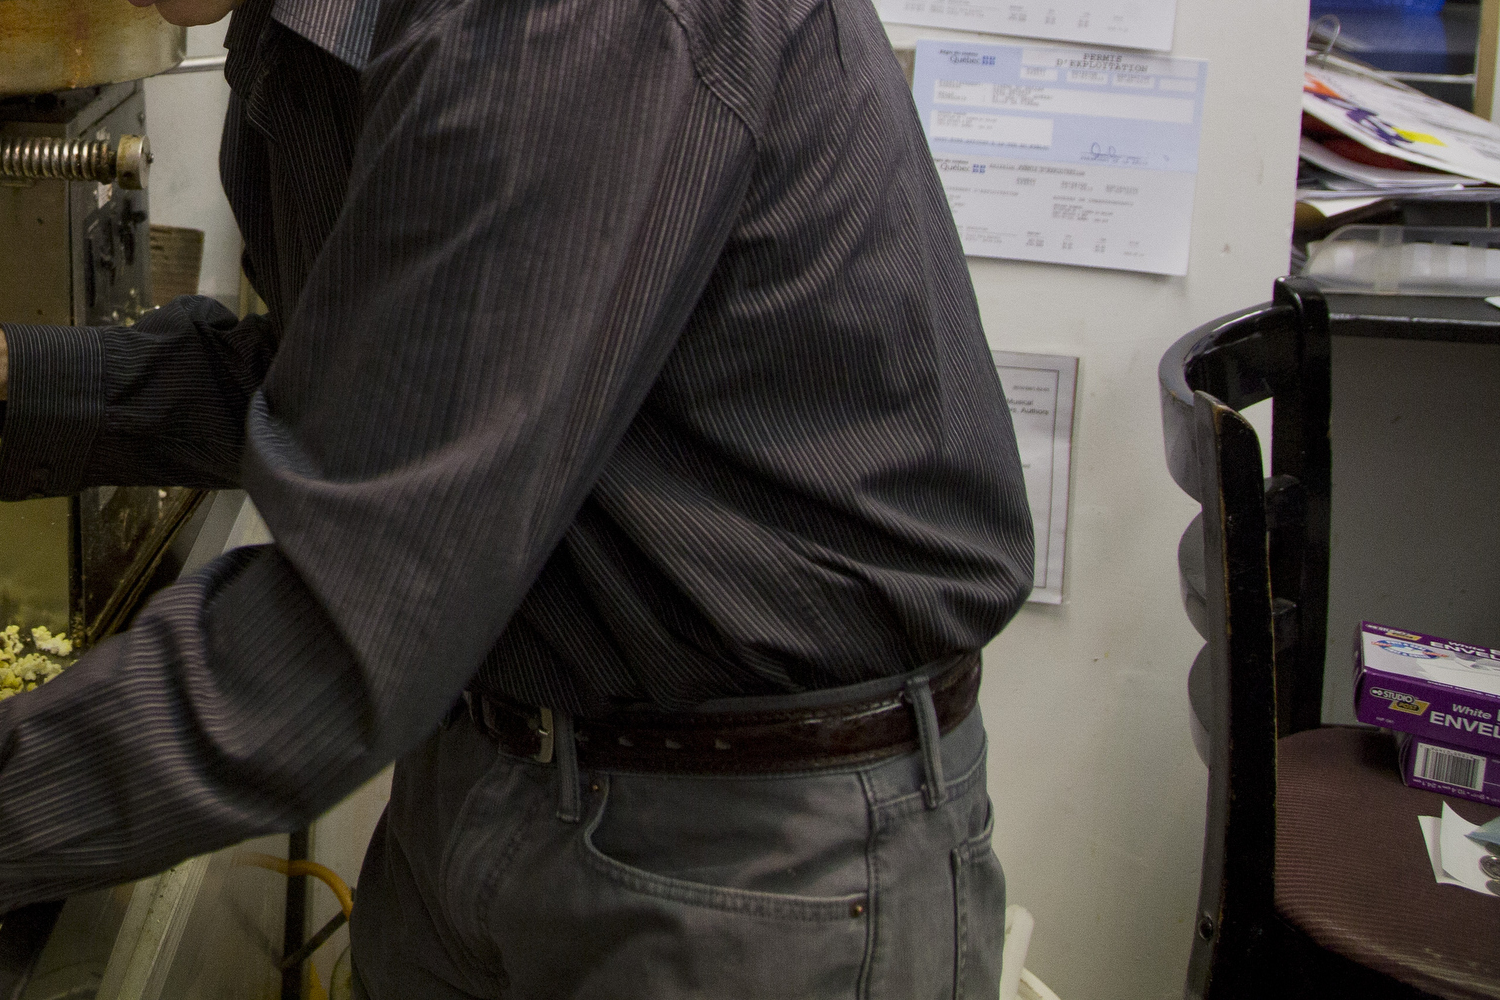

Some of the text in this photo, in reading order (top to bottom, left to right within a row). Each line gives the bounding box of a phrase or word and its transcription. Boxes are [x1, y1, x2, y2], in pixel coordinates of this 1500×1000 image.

[1083, 52, 1123, 63] PERMIS
[1056, 58, 1149, 73] D'EXPLOITATION
[1383, 690, 1413, 703] STUDIO
[1452, 703, 1492, 720] White
